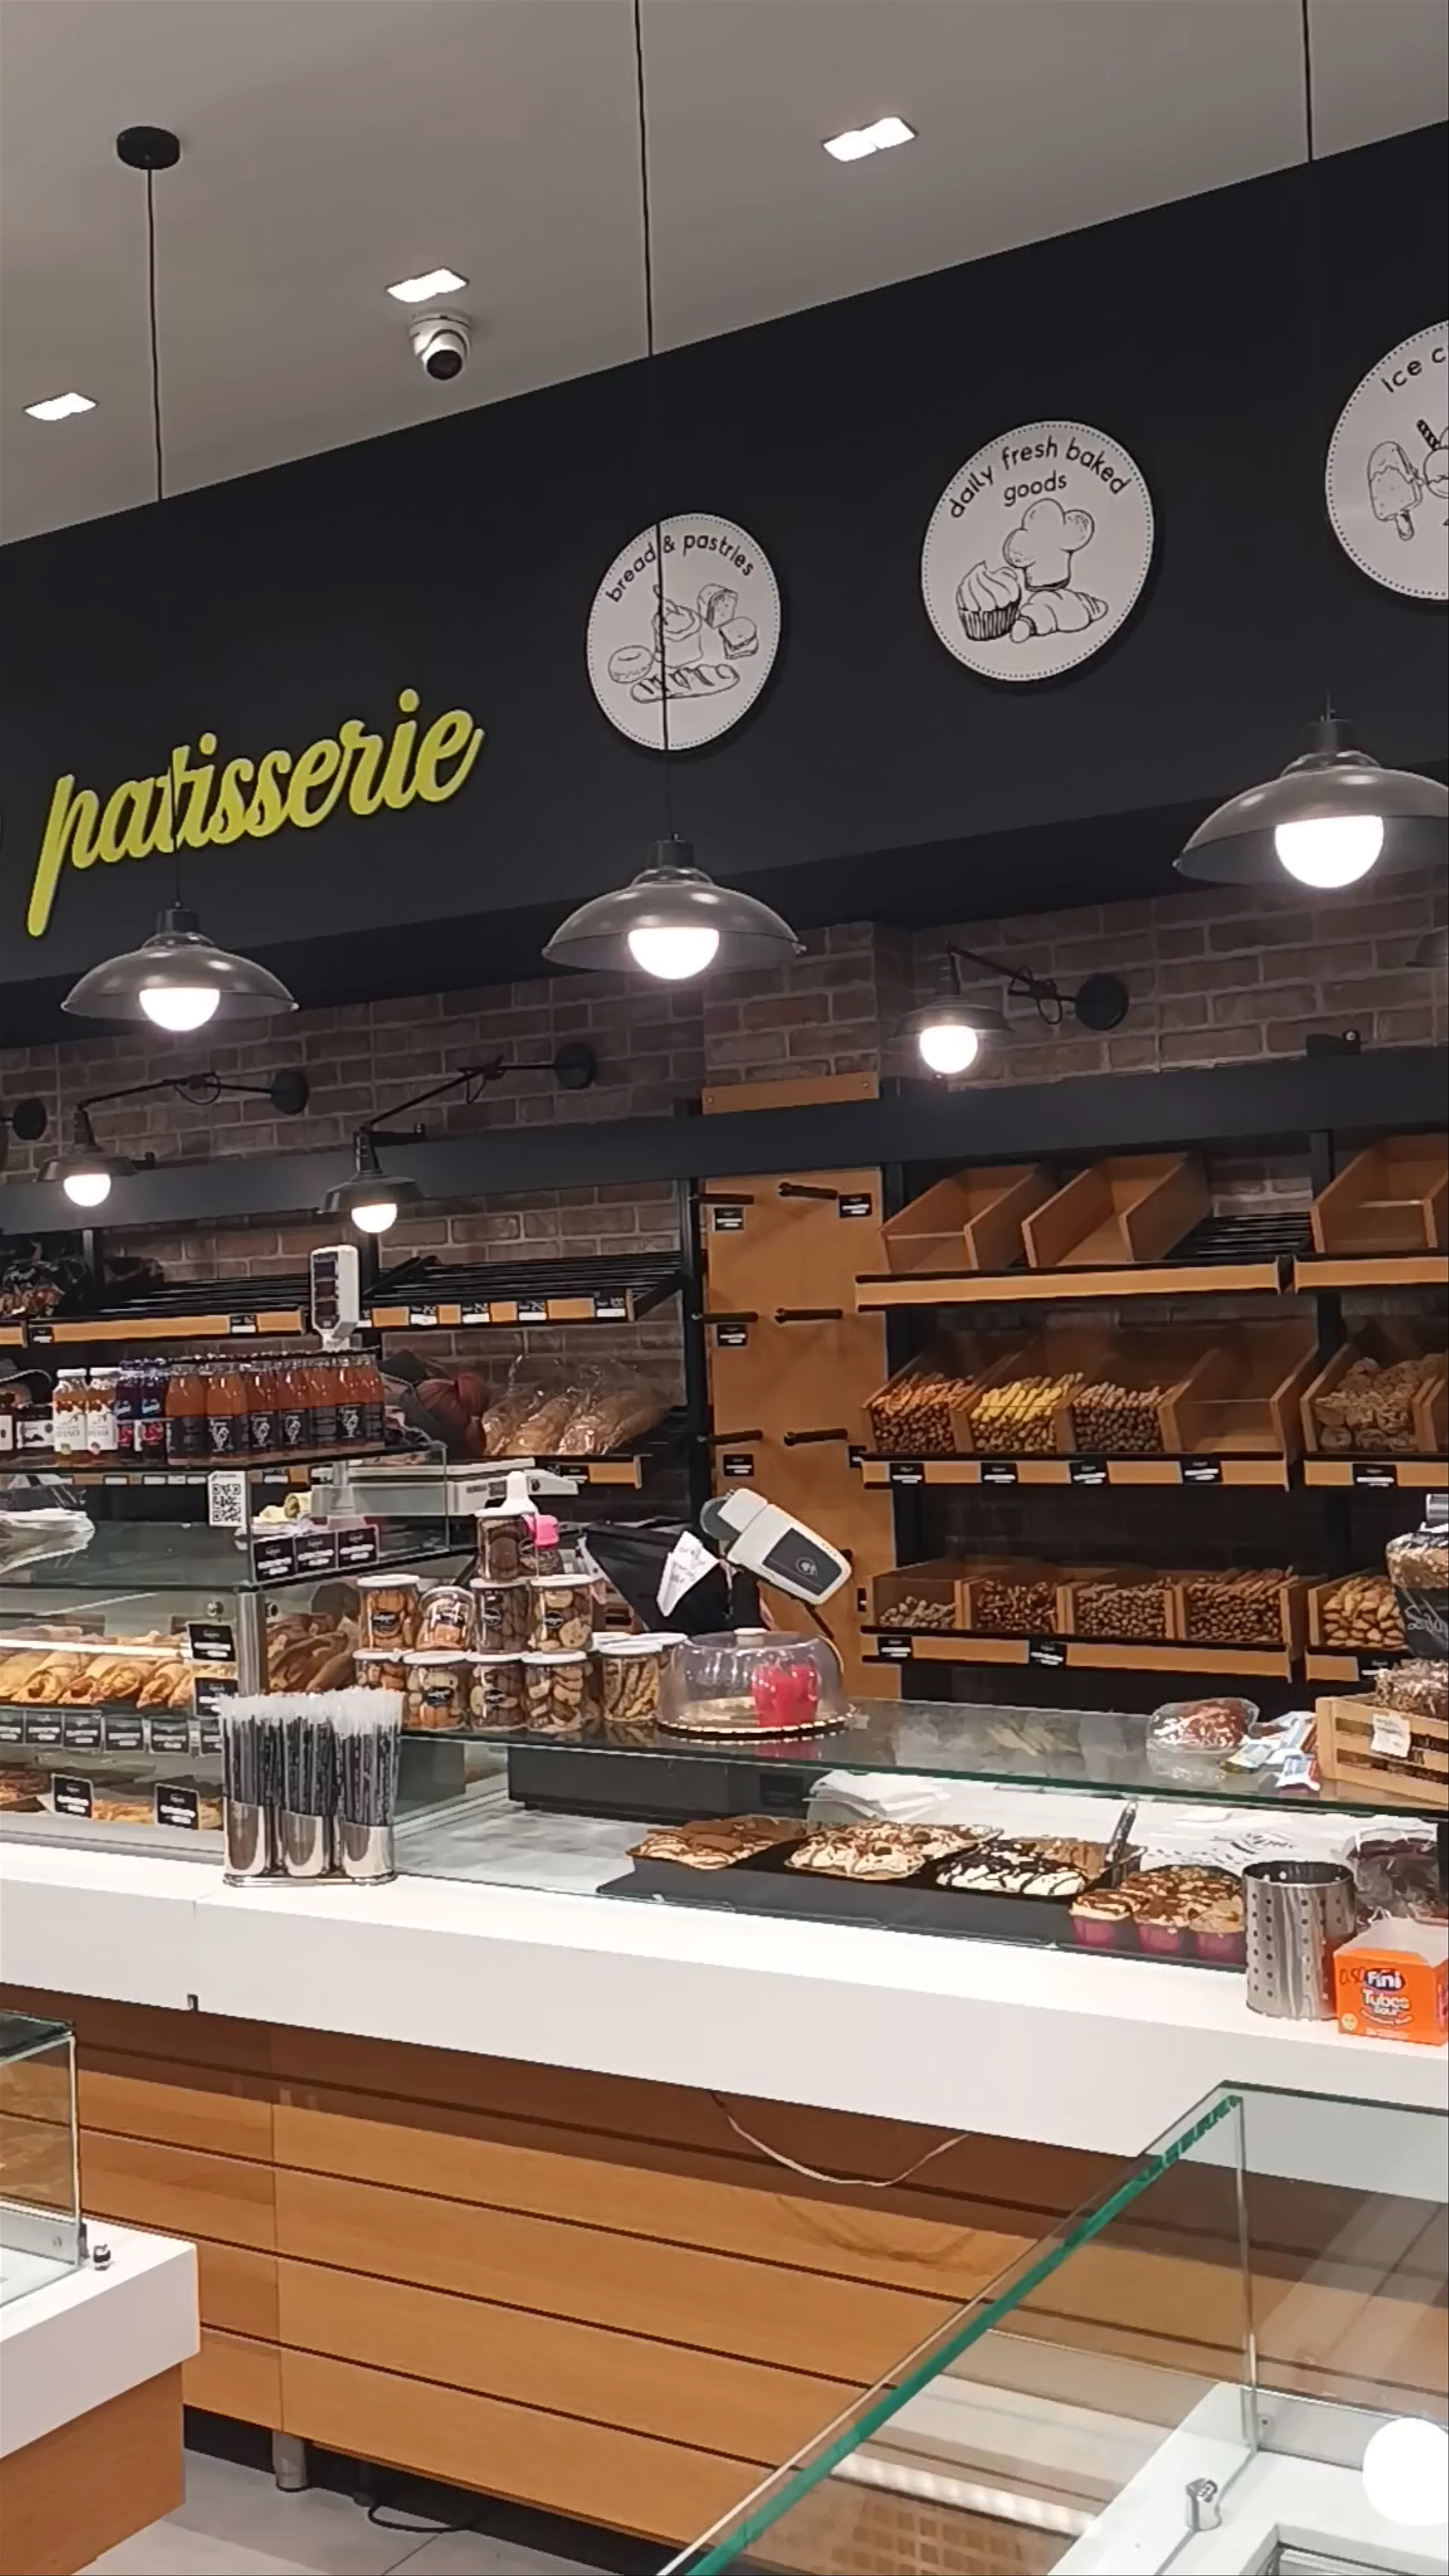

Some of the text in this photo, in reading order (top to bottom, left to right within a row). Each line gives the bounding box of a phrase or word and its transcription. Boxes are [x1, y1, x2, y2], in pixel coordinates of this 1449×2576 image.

[1381, 344, 1449, 393] ice c
[950, 435, 1132, 519] daily fresh baked
[1004, 471, 1067, 507] goods
[605, 534, 754, 602] bread & pastries
[27, 688, 484, 937] patisserie
[1362, 1988, 1410, 2010] Tubes
